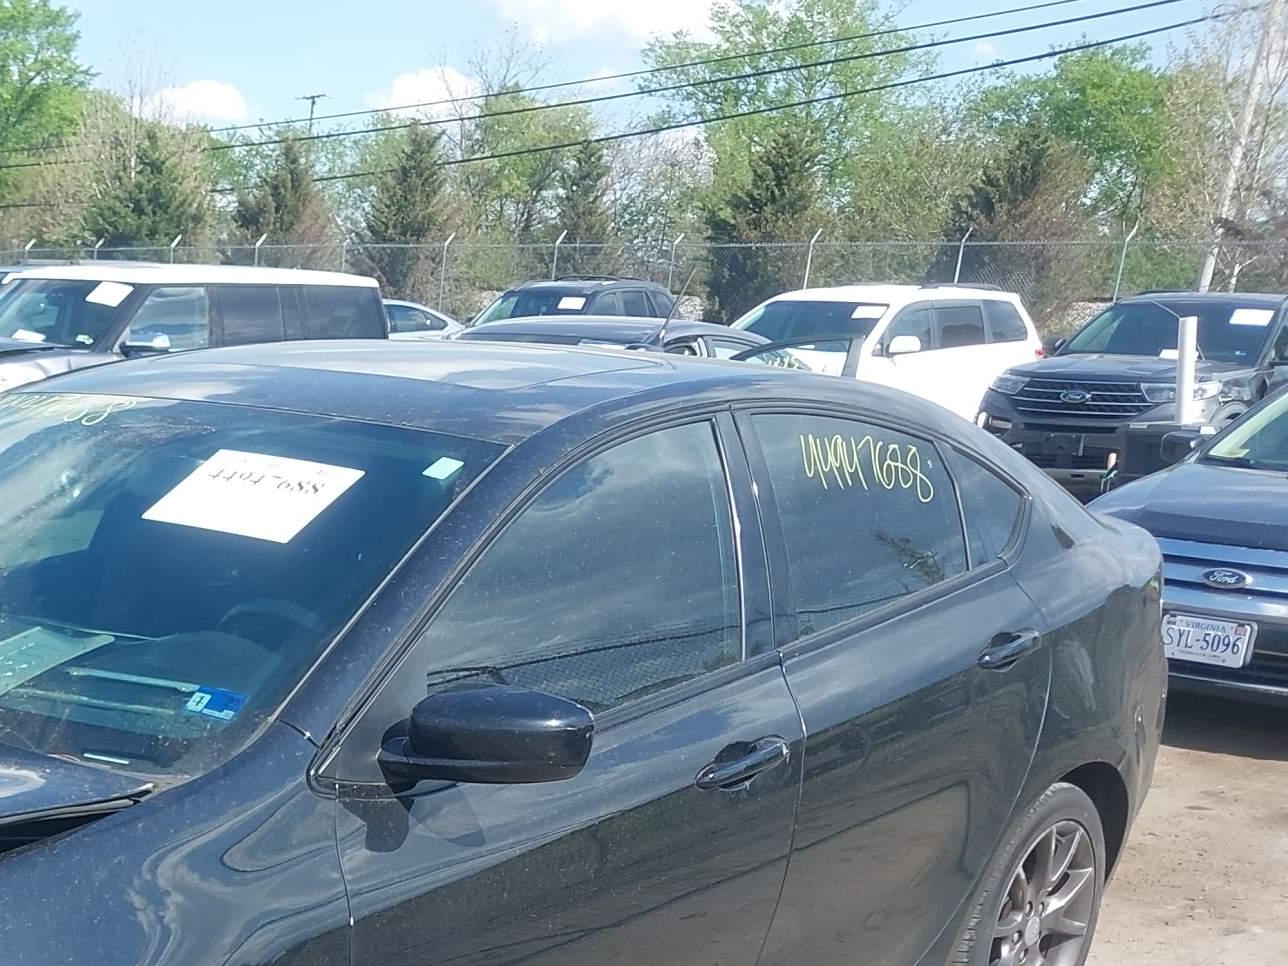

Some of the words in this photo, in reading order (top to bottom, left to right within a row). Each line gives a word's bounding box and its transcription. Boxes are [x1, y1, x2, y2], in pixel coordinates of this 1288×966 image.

[1209, 569, 1239, 585] Ford
[1185, 620, 1228, 634] VIRGINIA
[1163, 626, 1244, 656] SYL-5096
